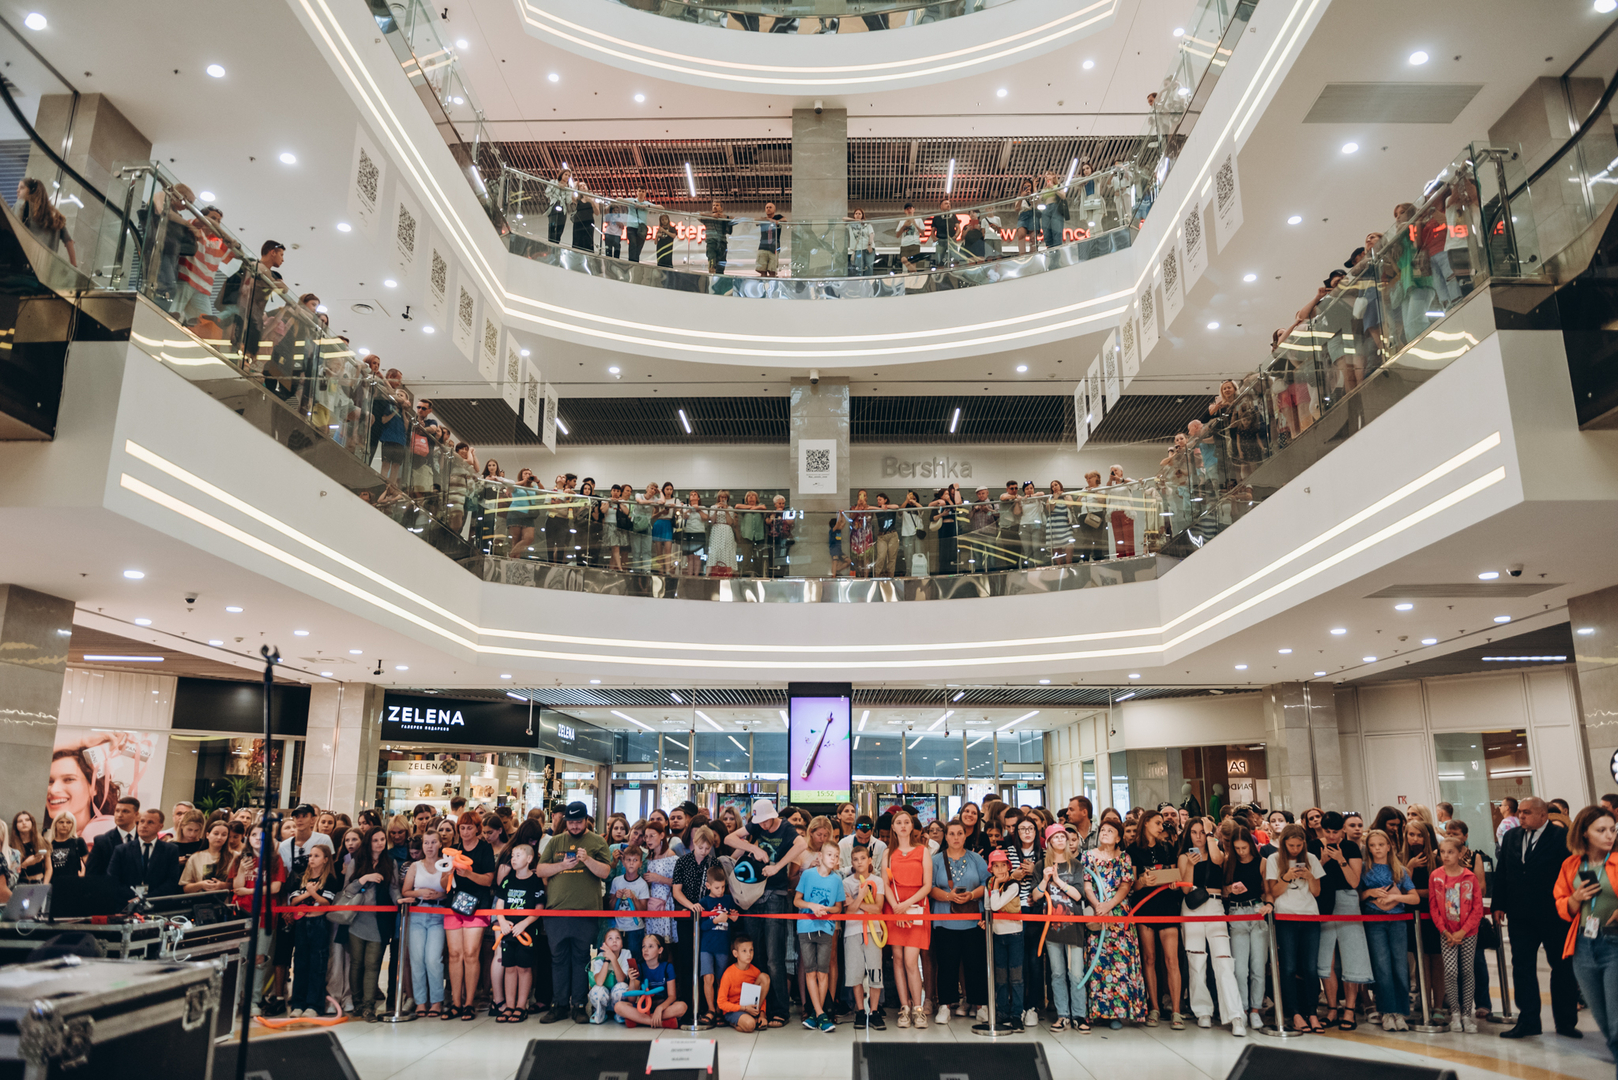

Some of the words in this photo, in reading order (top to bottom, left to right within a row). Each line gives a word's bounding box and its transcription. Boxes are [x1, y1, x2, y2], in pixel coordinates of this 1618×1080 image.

[881, 456, 973, 479] Bershka
[387, 705, 465, 726] ZELENA
[557, 723, 576, 741] ZELENA
